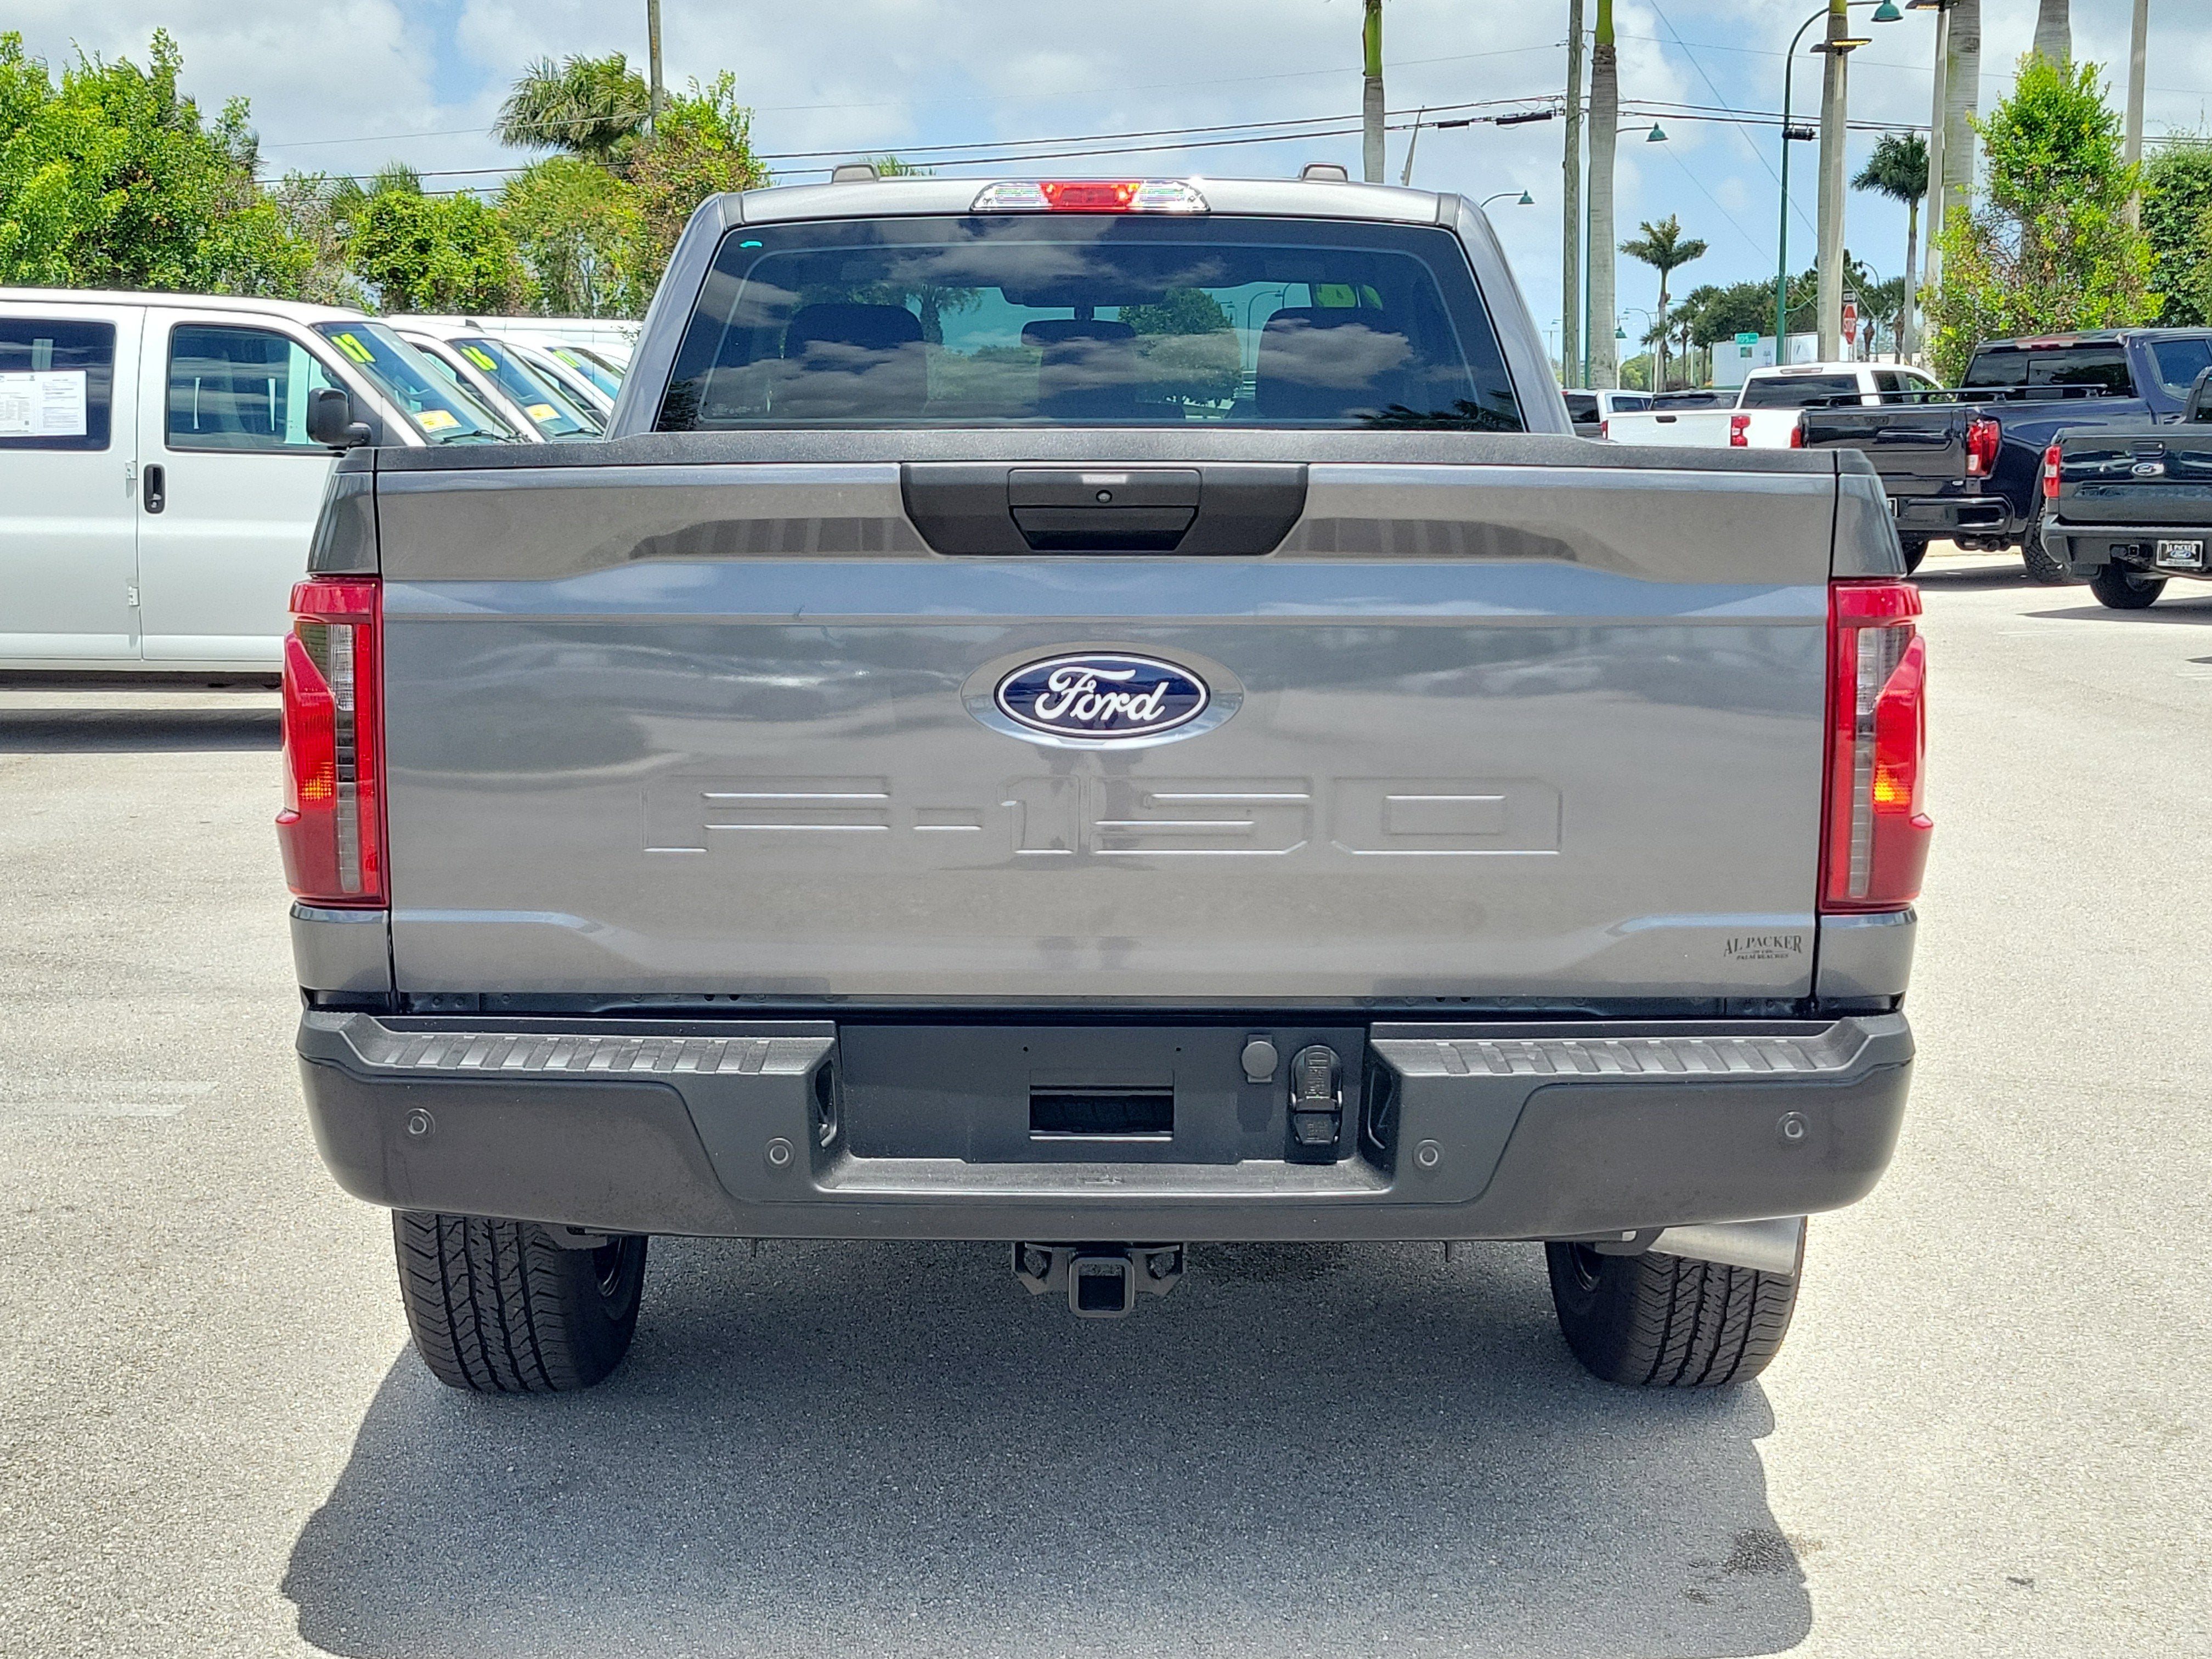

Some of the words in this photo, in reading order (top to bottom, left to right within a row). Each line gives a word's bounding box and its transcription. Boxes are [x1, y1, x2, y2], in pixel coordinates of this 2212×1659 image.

[1034, 665, 1170, 721] Ford
[642, 774, 1562, 855] F-150
[1723, 938, 1742, 957] AL
[1746, 935, 1802, 954] PACKER
